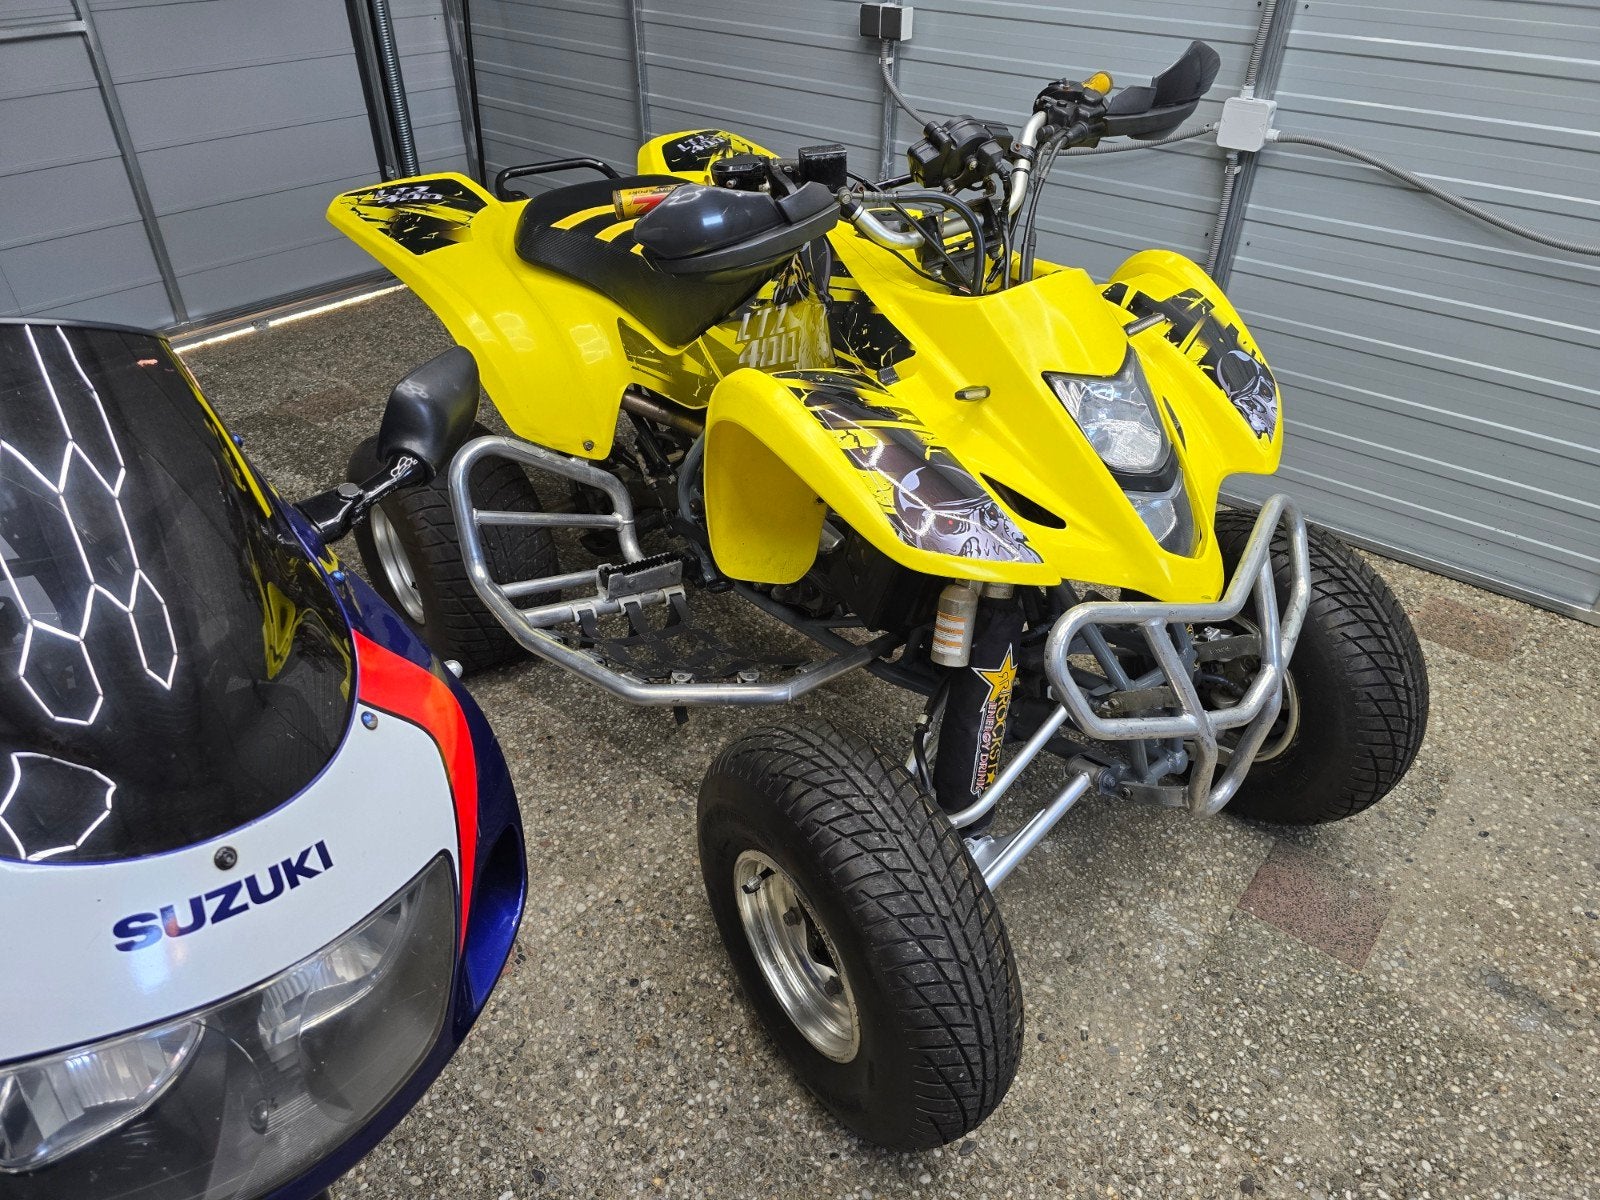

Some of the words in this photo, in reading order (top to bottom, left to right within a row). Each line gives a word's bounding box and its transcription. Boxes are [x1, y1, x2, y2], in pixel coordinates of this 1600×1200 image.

[676, 135, 710, 152] LTZ
[373, 185, 431, 200] LTZ
[378, 193, 443, 204] 400
[737, 302, 788, 341] LTZ
[738, 331, 798, 368] 400
[981, 701, 998, 750] ENERGY
[975, 752, 989, 791] DRINK
[113, 840, 334, 952] SUZUKI
